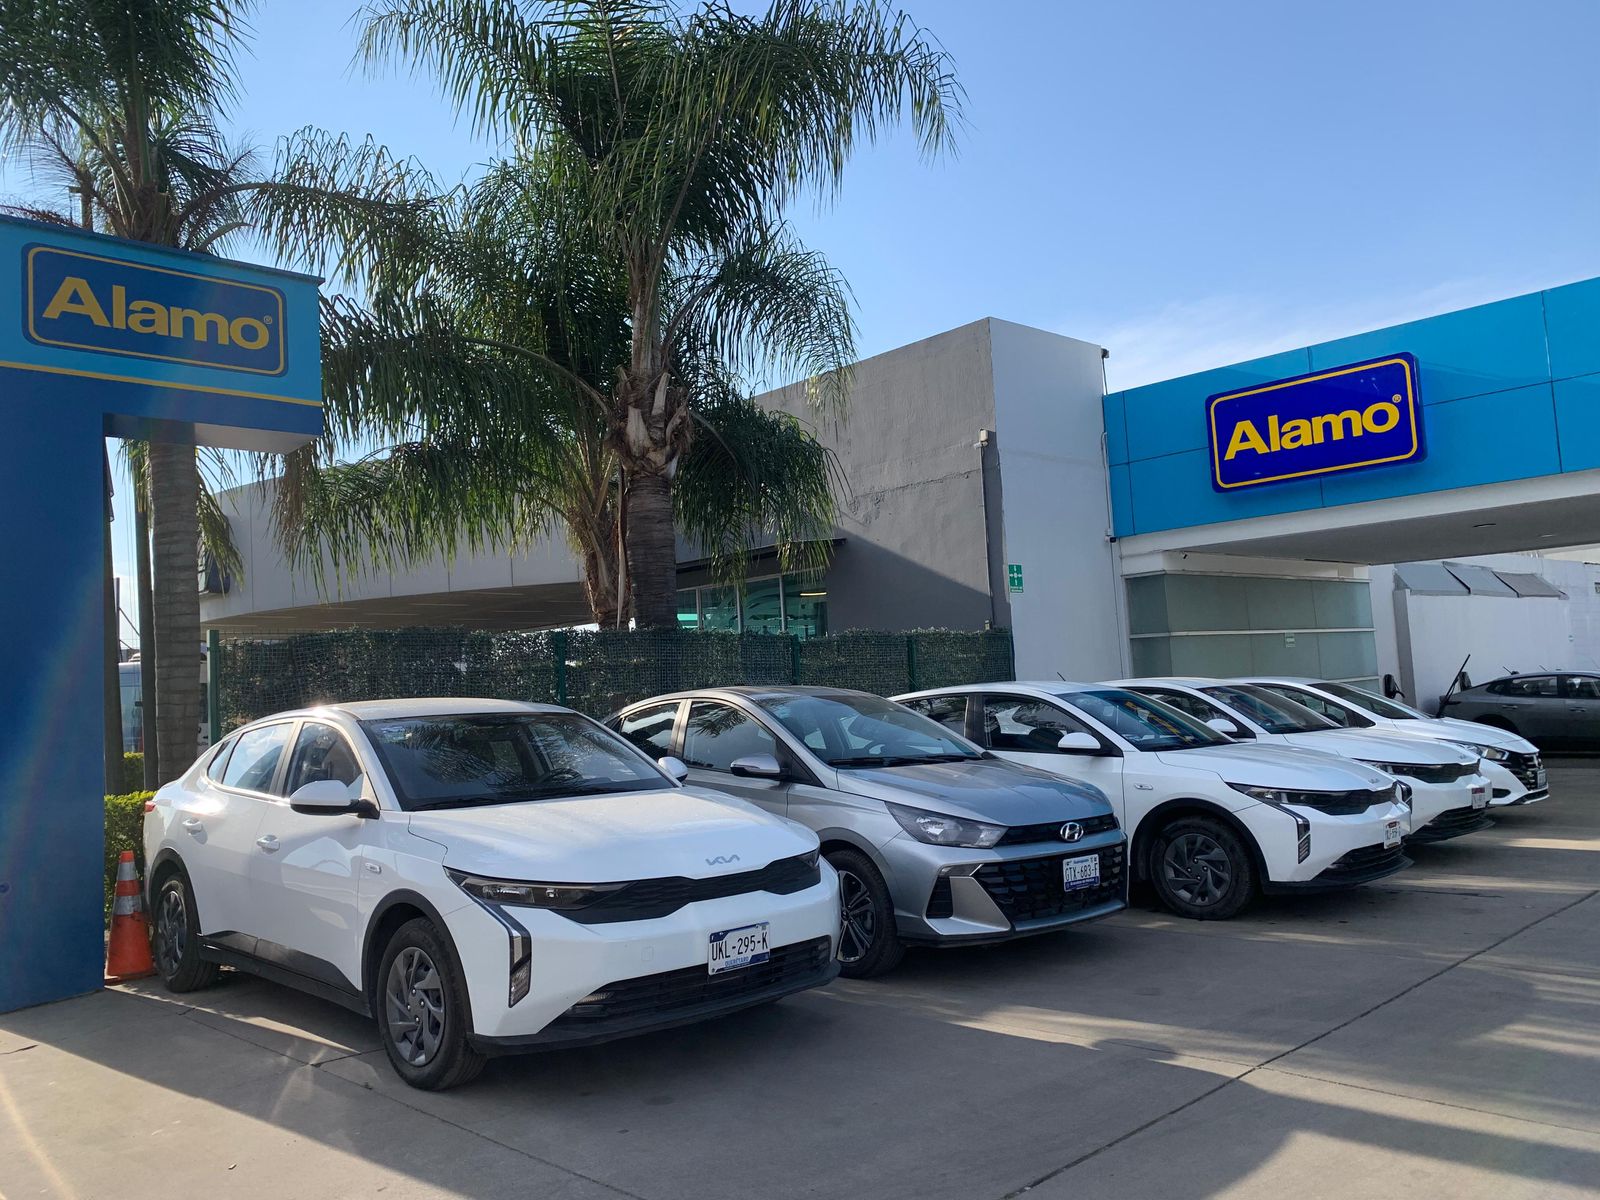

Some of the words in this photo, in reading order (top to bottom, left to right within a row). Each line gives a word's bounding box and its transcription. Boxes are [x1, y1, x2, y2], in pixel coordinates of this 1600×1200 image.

[42, 276, 271, 350] Alamo
[1224, 401, 1400, 460] Alamo
[711, 932, 768, 961] UKL-295-K
